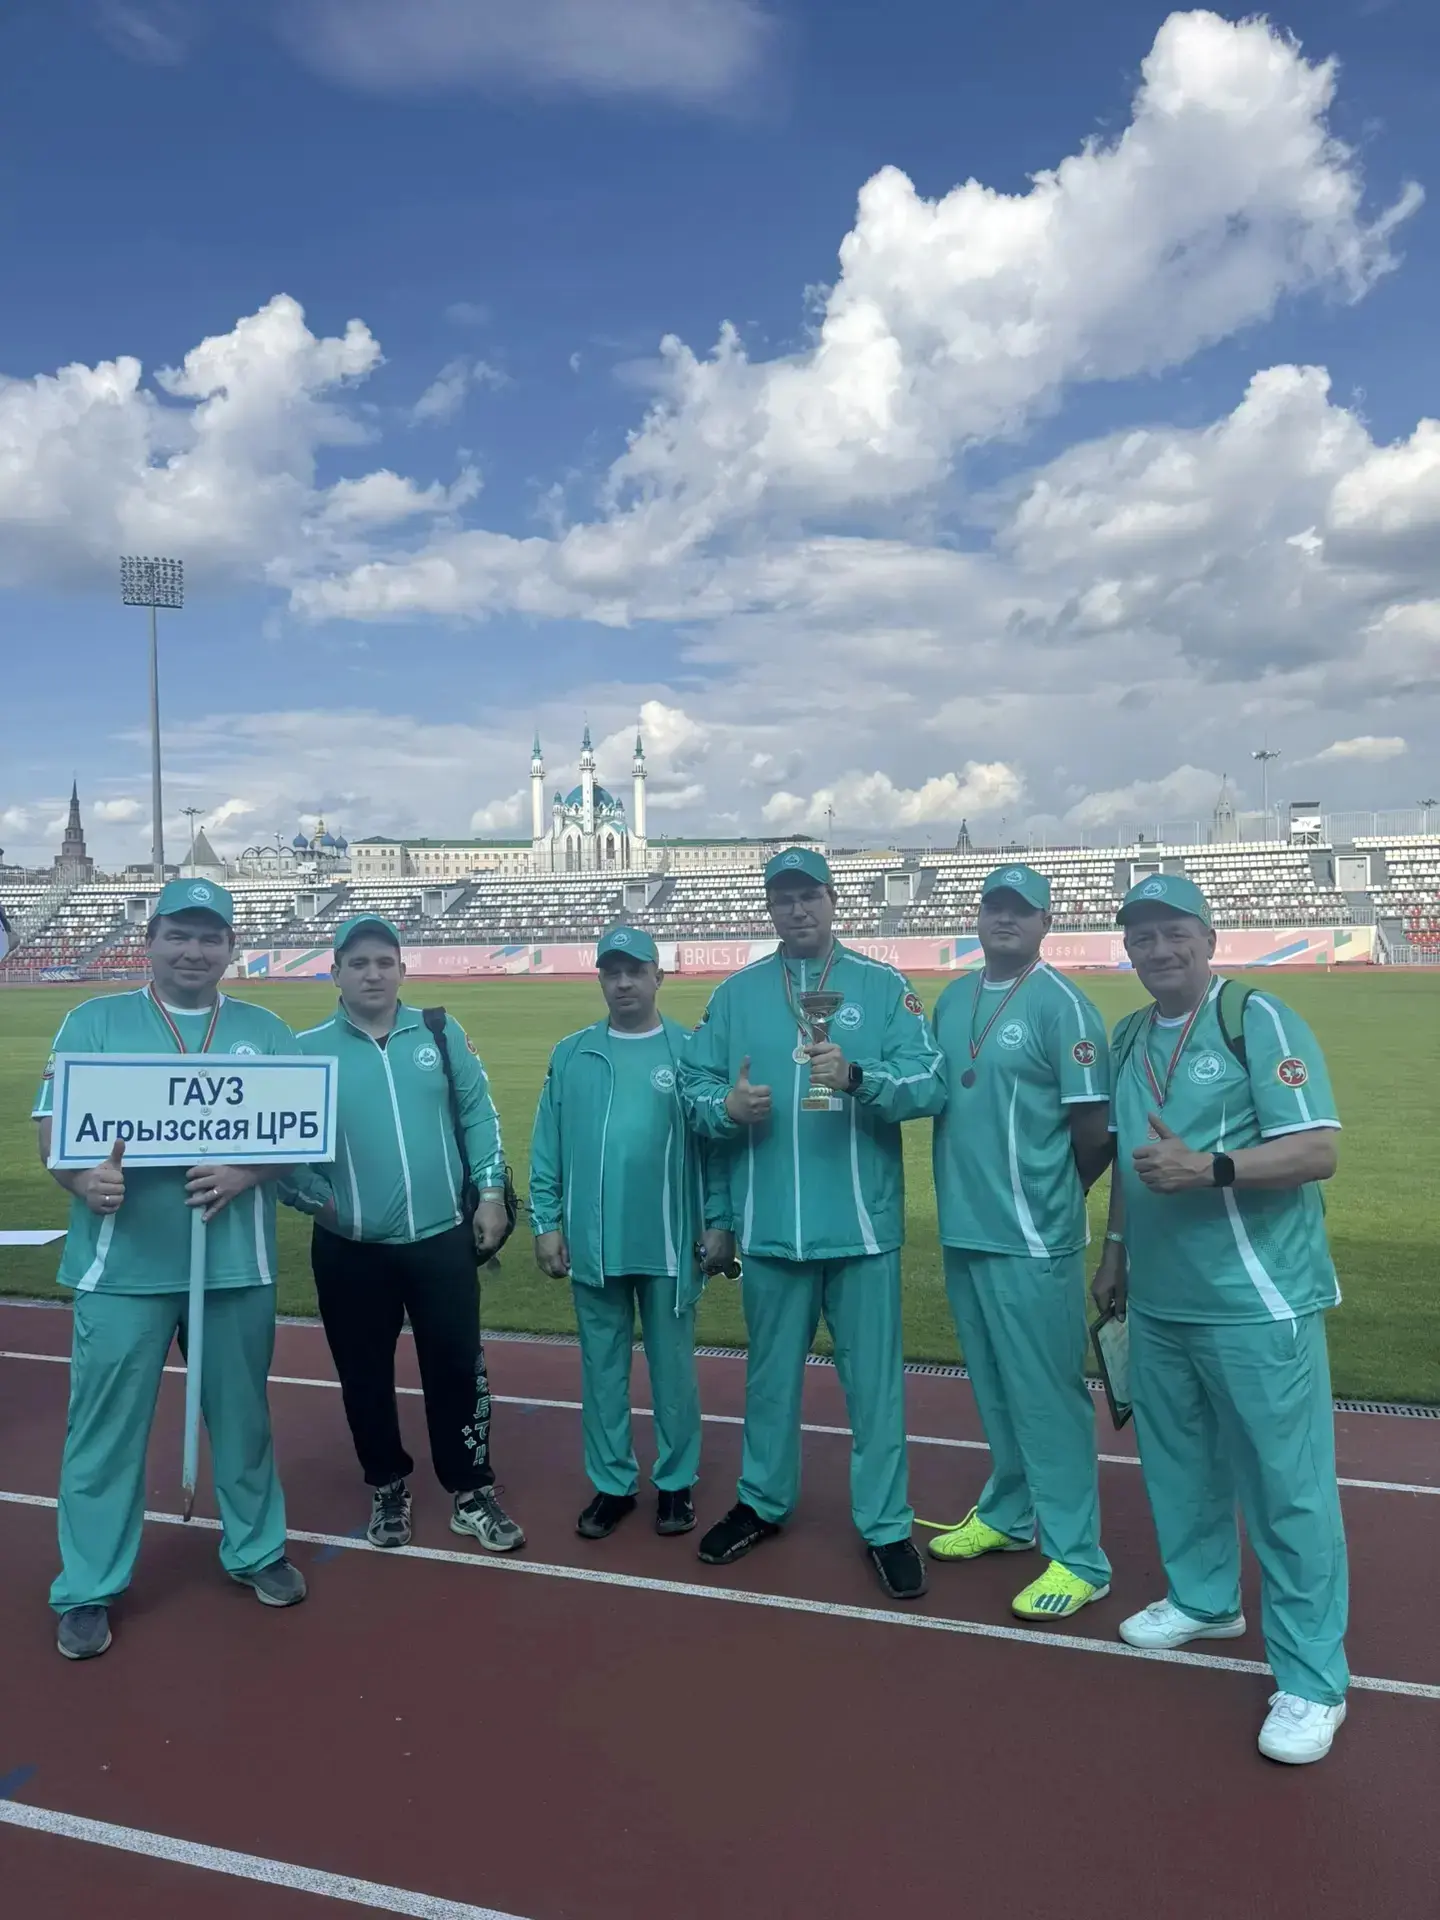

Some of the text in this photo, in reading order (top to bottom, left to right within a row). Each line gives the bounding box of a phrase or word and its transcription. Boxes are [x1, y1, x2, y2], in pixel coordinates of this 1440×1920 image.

[684, 947, 731, 966] BRICS
[168, 1076, 244, 1107] ГАУЗ
[75, 1110, 319, 1145] Агрызская ЦРБ
